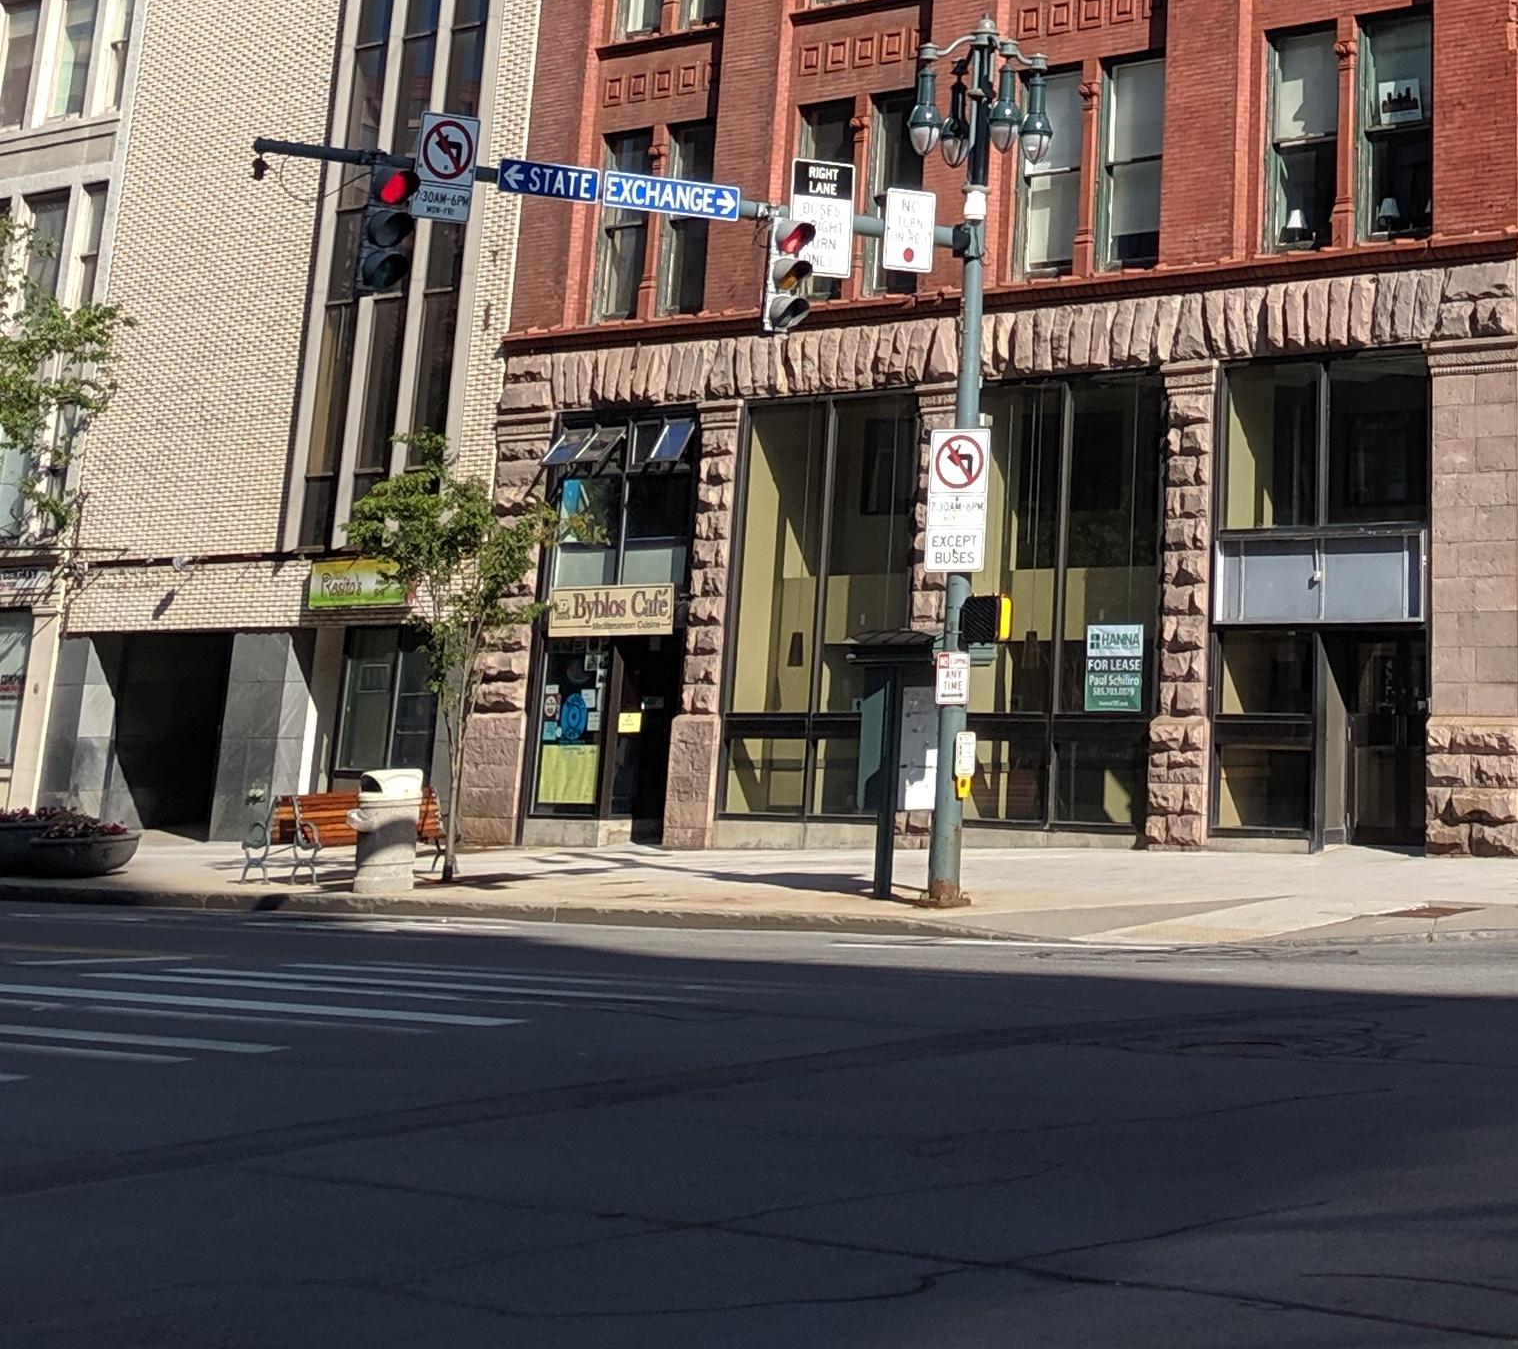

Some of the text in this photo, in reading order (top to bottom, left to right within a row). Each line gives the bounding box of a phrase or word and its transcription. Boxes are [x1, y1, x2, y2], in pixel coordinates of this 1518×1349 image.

[808, 166, 840, 180] RIGHT
[528, 166, 593, 199] STATE
[808, 182, 838, 196] LANE
[606, 176, 717, 214] EXCHANGE
[931, 534, 977, 548] EXCEPT
[934, 551, 975, 564] BUSES
[572, 588, 669, 624] Byblos Café
[1102, 632, 1140, 646] HANNA
[1087, 659, 1141, 671] FOR LEASE
[944, 670, 962, 680] ANY
[1088, 673, 1107, 686] Paul
[944, 681, 963, 691] TIME
